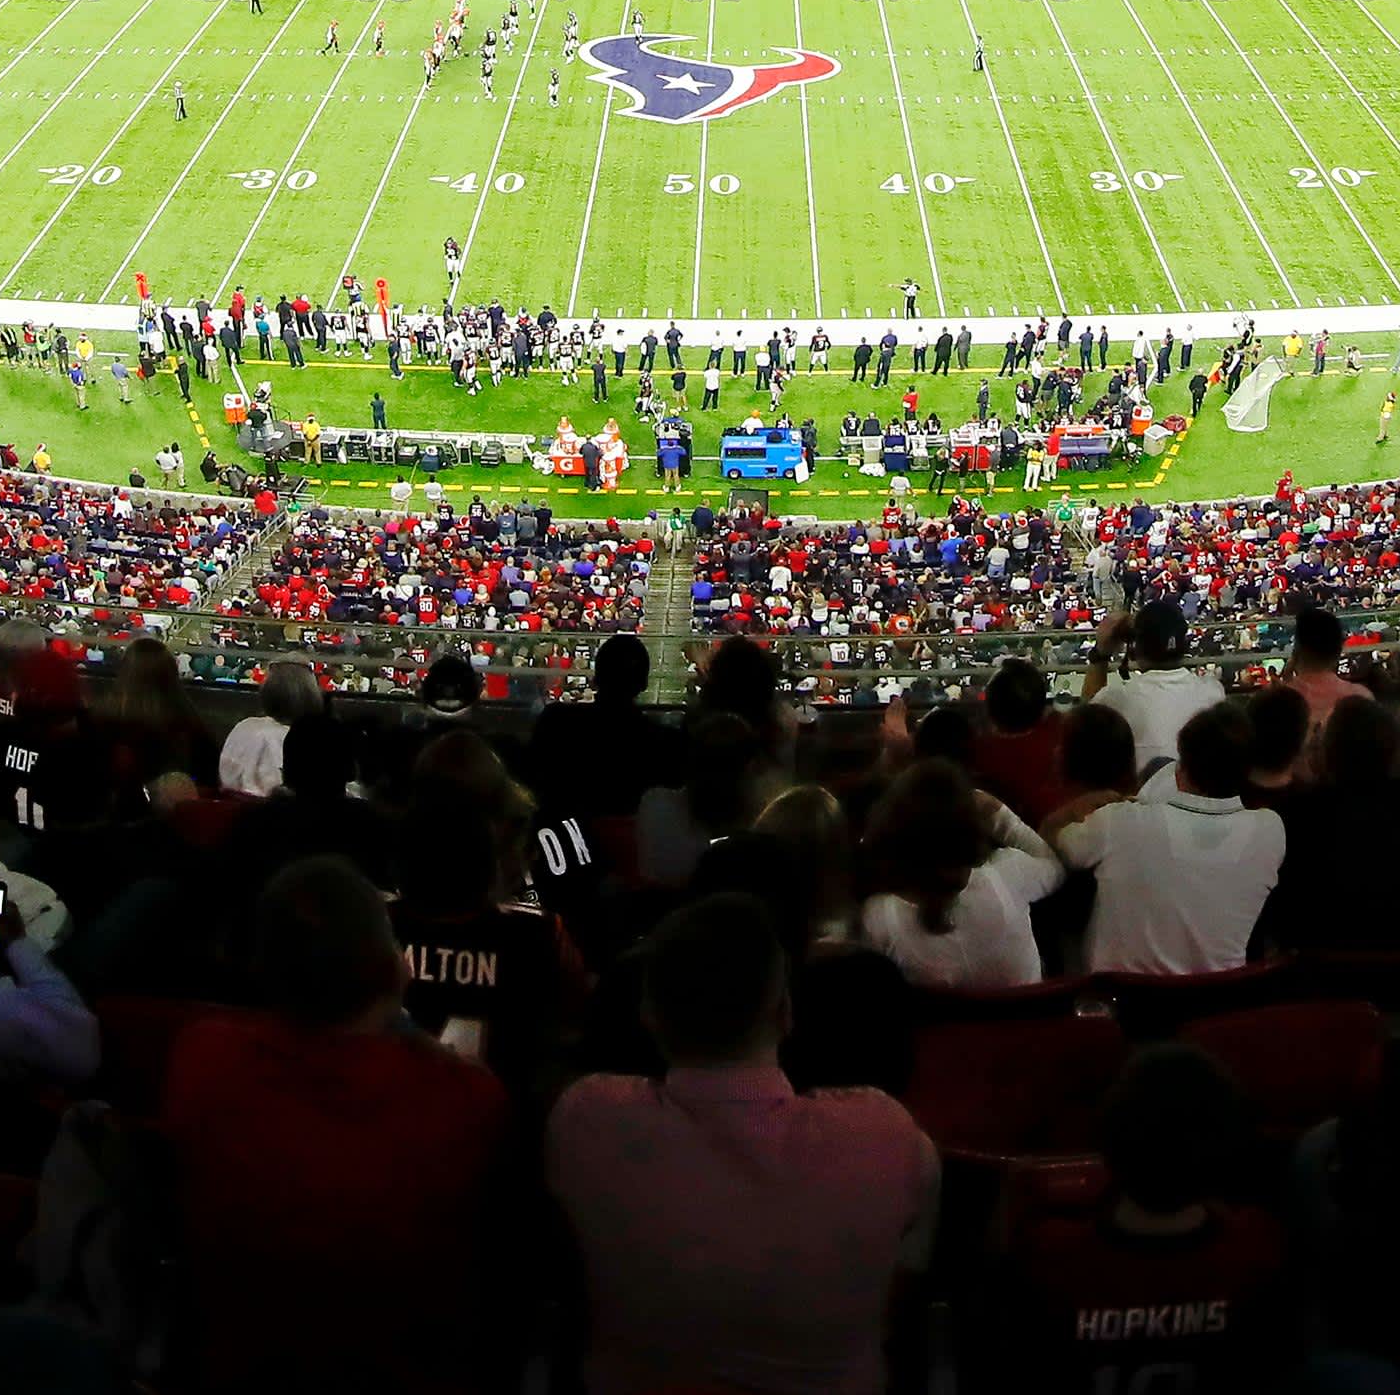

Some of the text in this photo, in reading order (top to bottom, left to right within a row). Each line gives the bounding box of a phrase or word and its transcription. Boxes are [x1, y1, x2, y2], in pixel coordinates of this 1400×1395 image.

[49, 165, 123, 187] 20
[241, 168, 319, 190] 30
[448, 172, 526, 195] 40
[663, 173, 742, 196] 50
[879, 172, 956, 196] 40
[1088, 170, 1165, 193] 30
[1288, 166, 1362, 189] 20
[1075, 1298, 1233, 1341] HOPKINS
